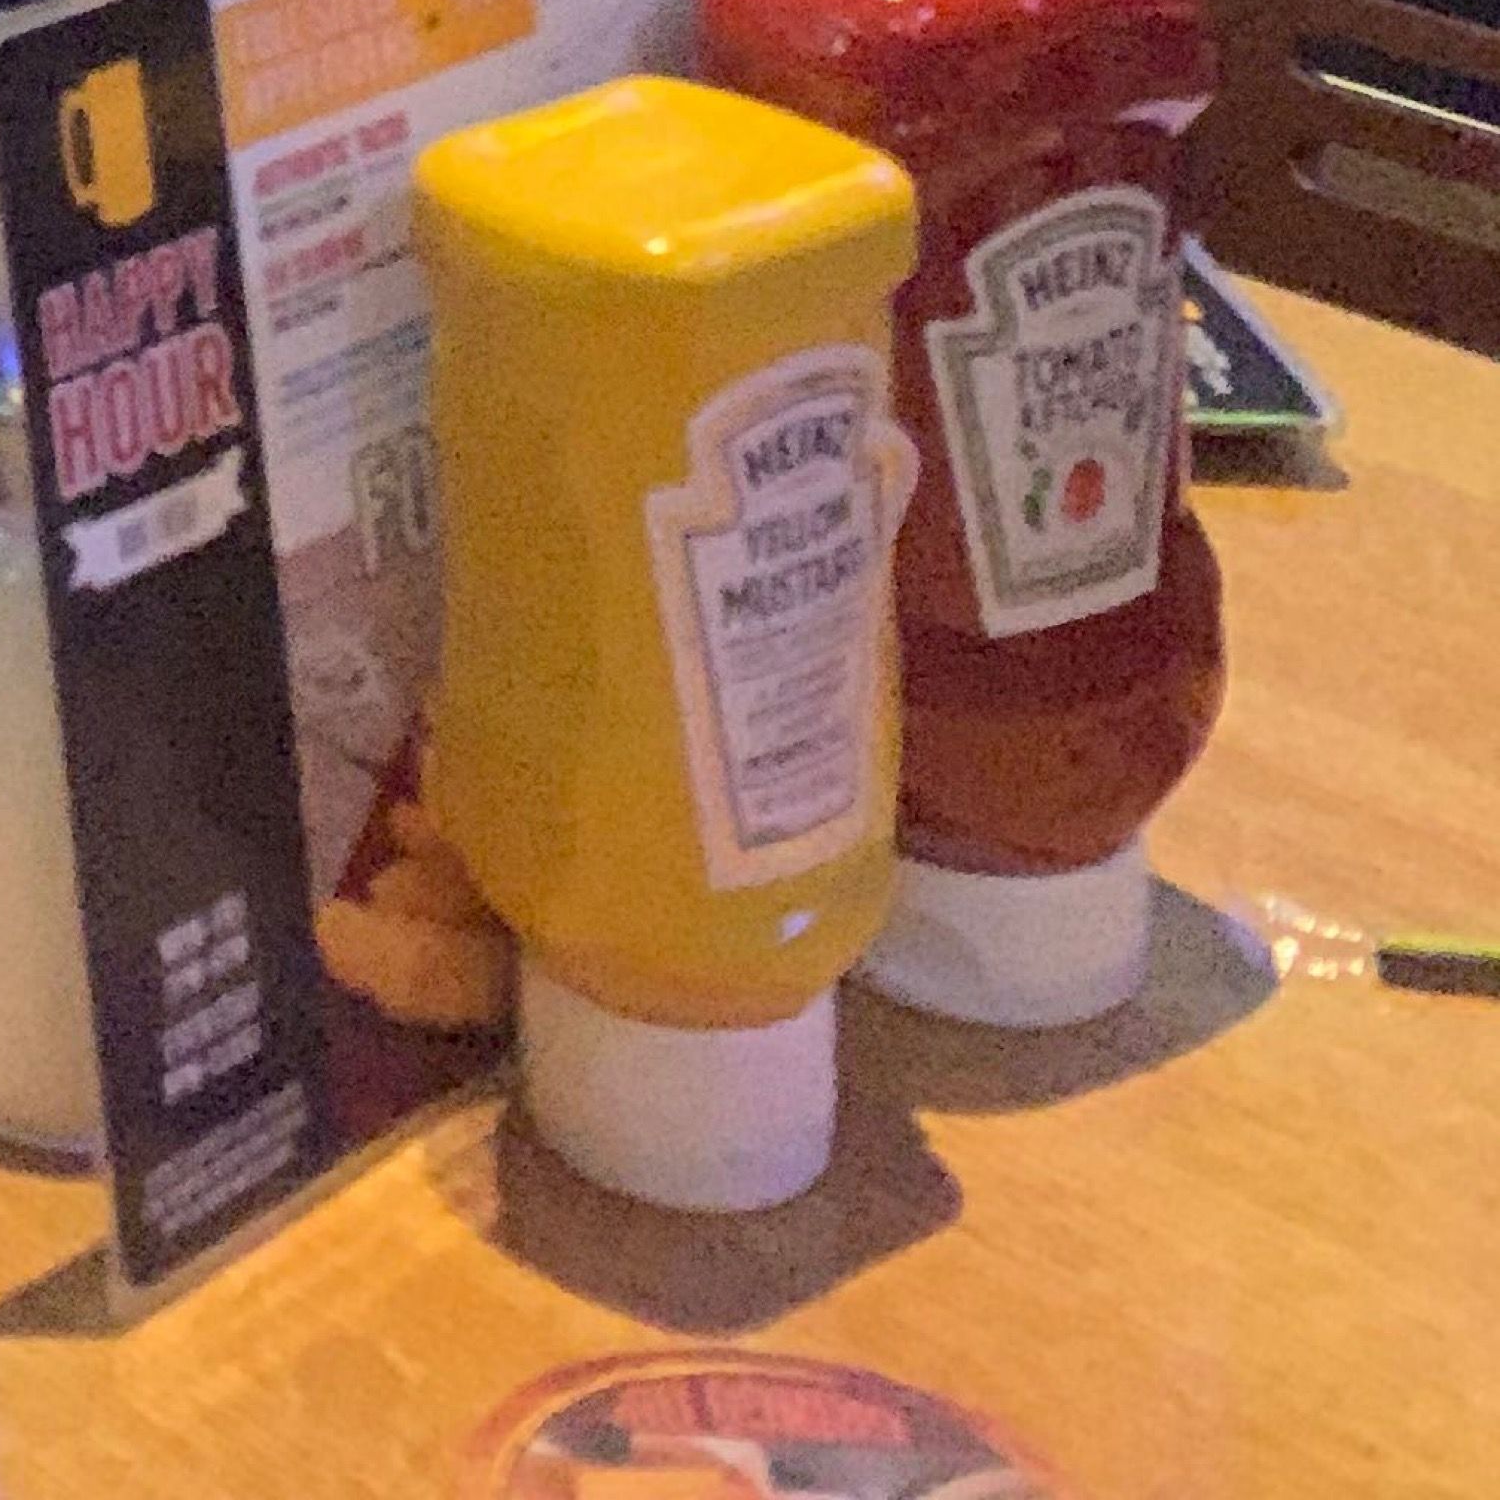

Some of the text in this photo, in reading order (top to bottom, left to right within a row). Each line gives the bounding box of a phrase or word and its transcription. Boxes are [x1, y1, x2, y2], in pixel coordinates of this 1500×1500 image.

[38, 225, 218, 379] HAPPY
[1018, 240, 1136, 312] HEINZ
[48, 321, 244, 499] HOUR
